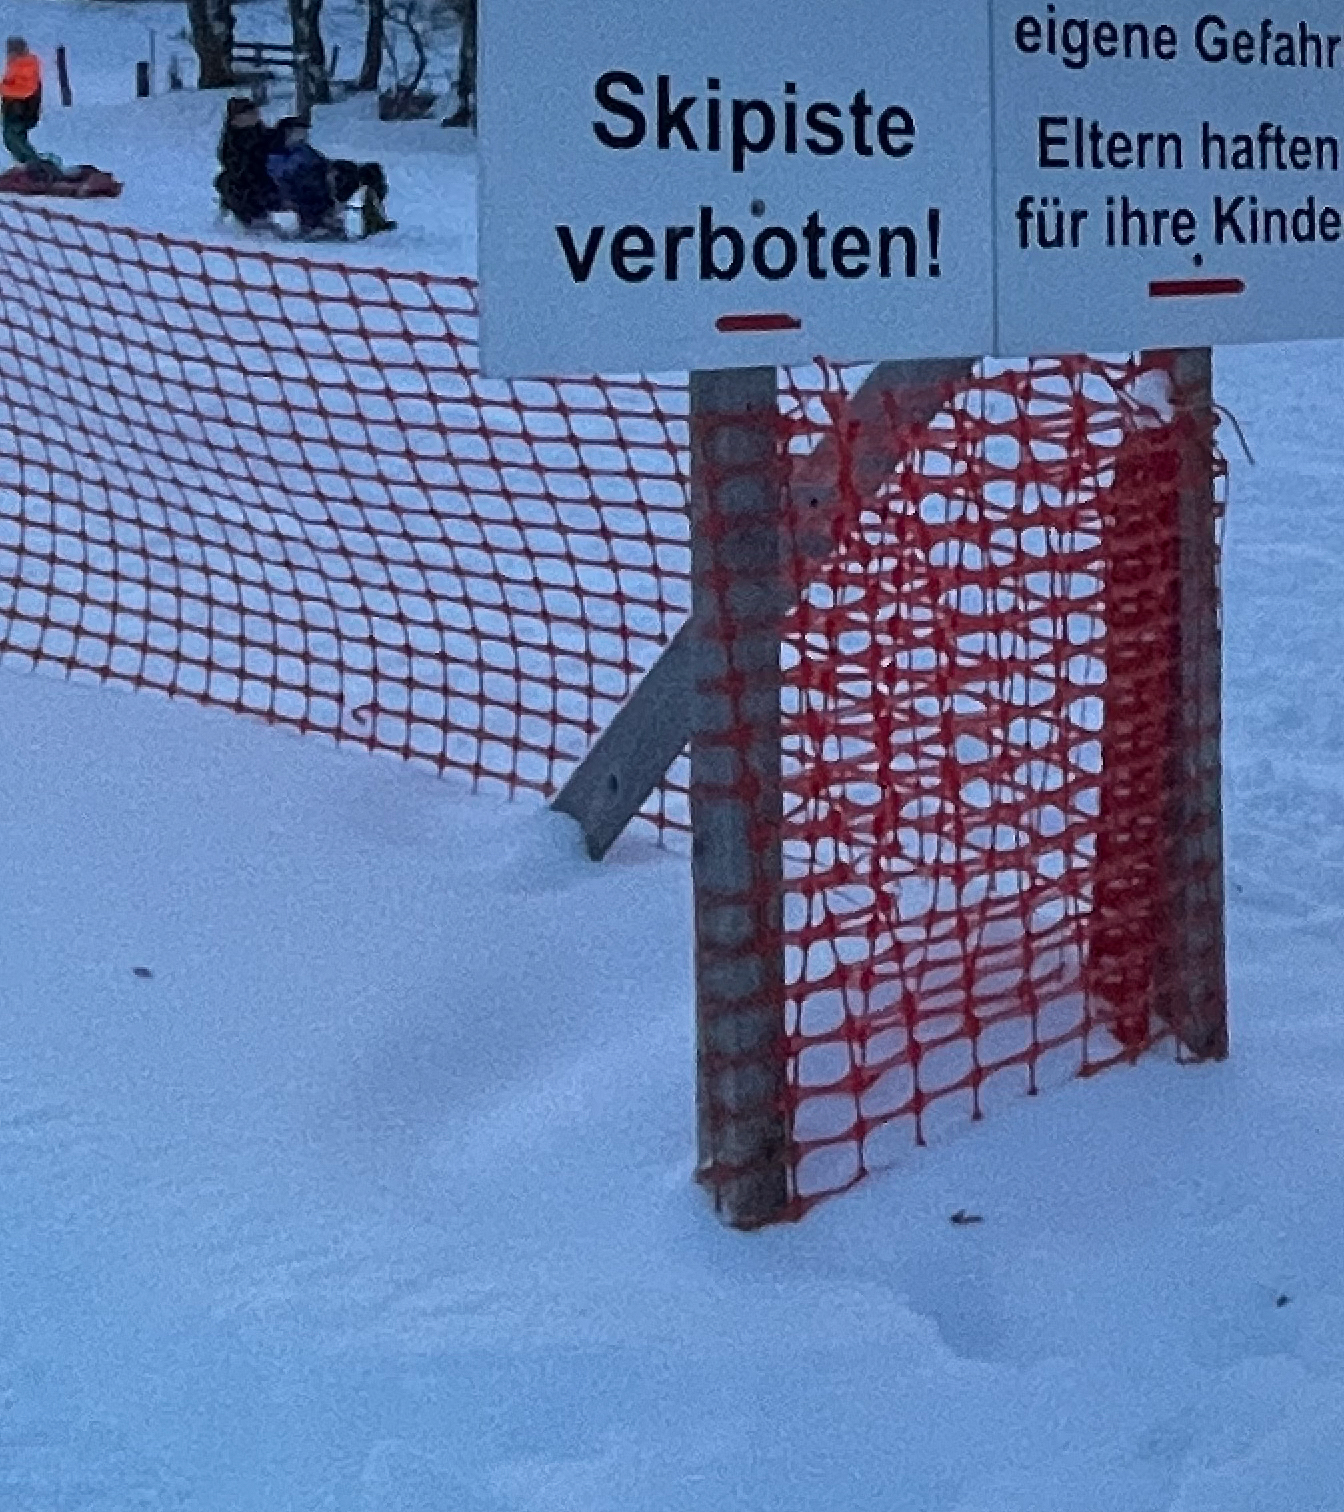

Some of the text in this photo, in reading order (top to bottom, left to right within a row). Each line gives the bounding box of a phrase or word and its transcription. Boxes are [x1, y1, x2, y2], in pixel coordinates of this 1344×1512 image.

[1014, 3, 1178, 70] eigene
[592, 69, 916, 173] Skipiste
[1037, 115, 1340, 171] Eltern haften
[555, 206, 942, 284] verboten!
[1015, 194, 1089, 249] für
[1105, 194, 1197, 247] ihre
